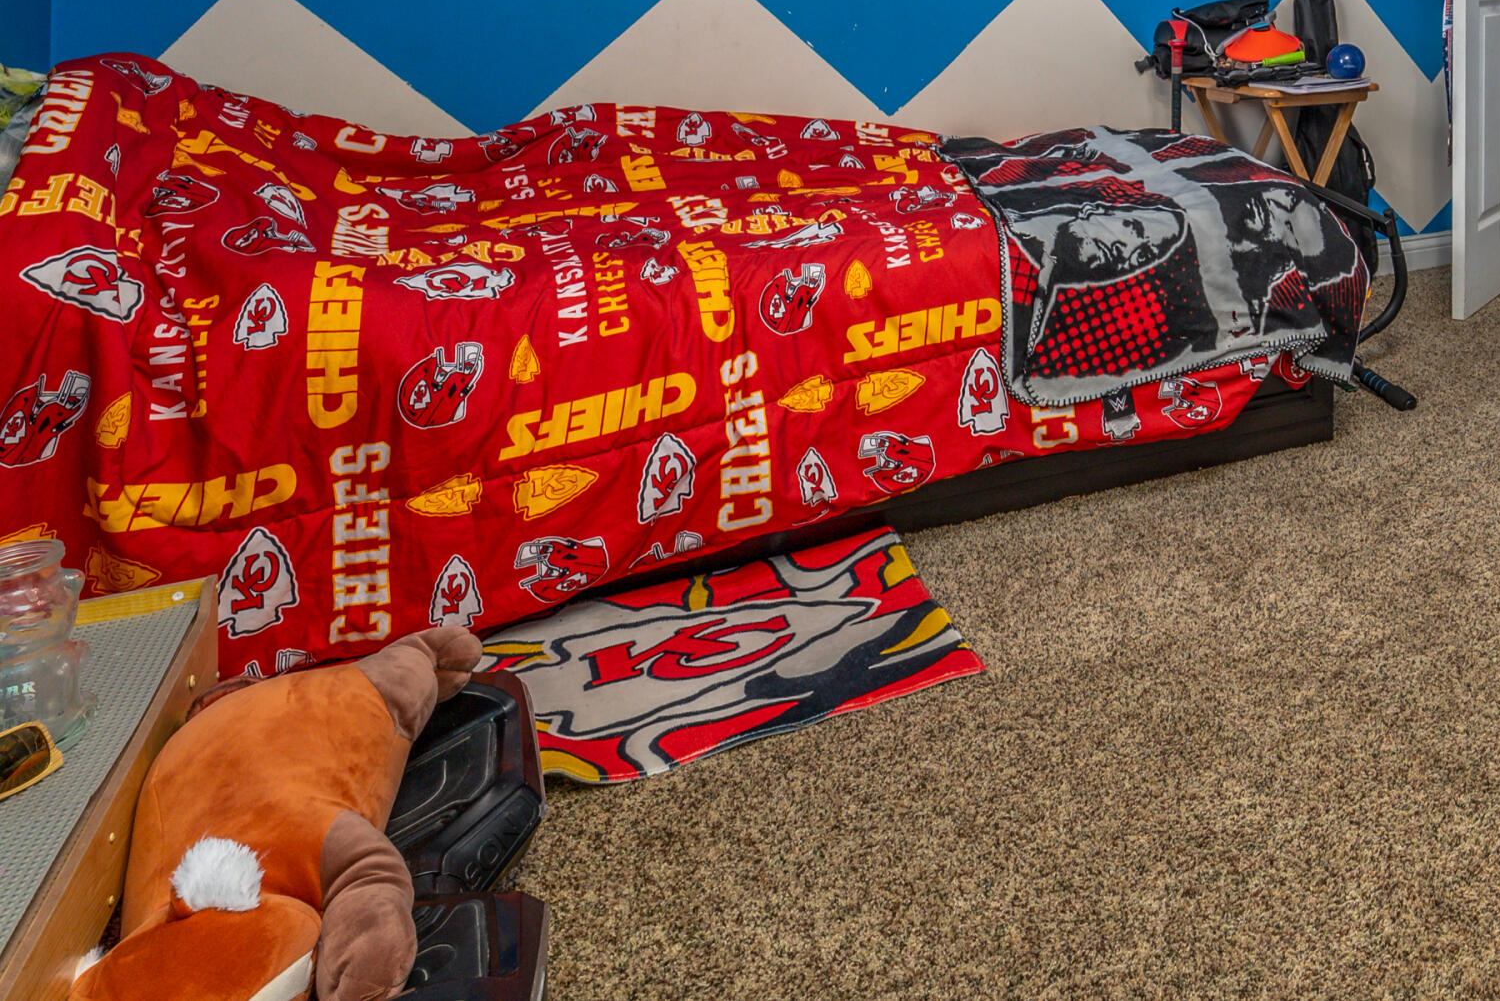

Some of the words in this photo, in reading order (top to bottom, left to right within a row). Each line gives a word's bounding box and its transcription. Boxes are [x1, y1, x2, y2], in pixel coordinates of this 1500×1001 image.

[843, 297, 1003, 365] CHIEFS
[498, 371, 697, 462] CHIEFS
[716, 350, 773, 533] CHIEFS
[328, 440, 391, 644] CHIEFS
